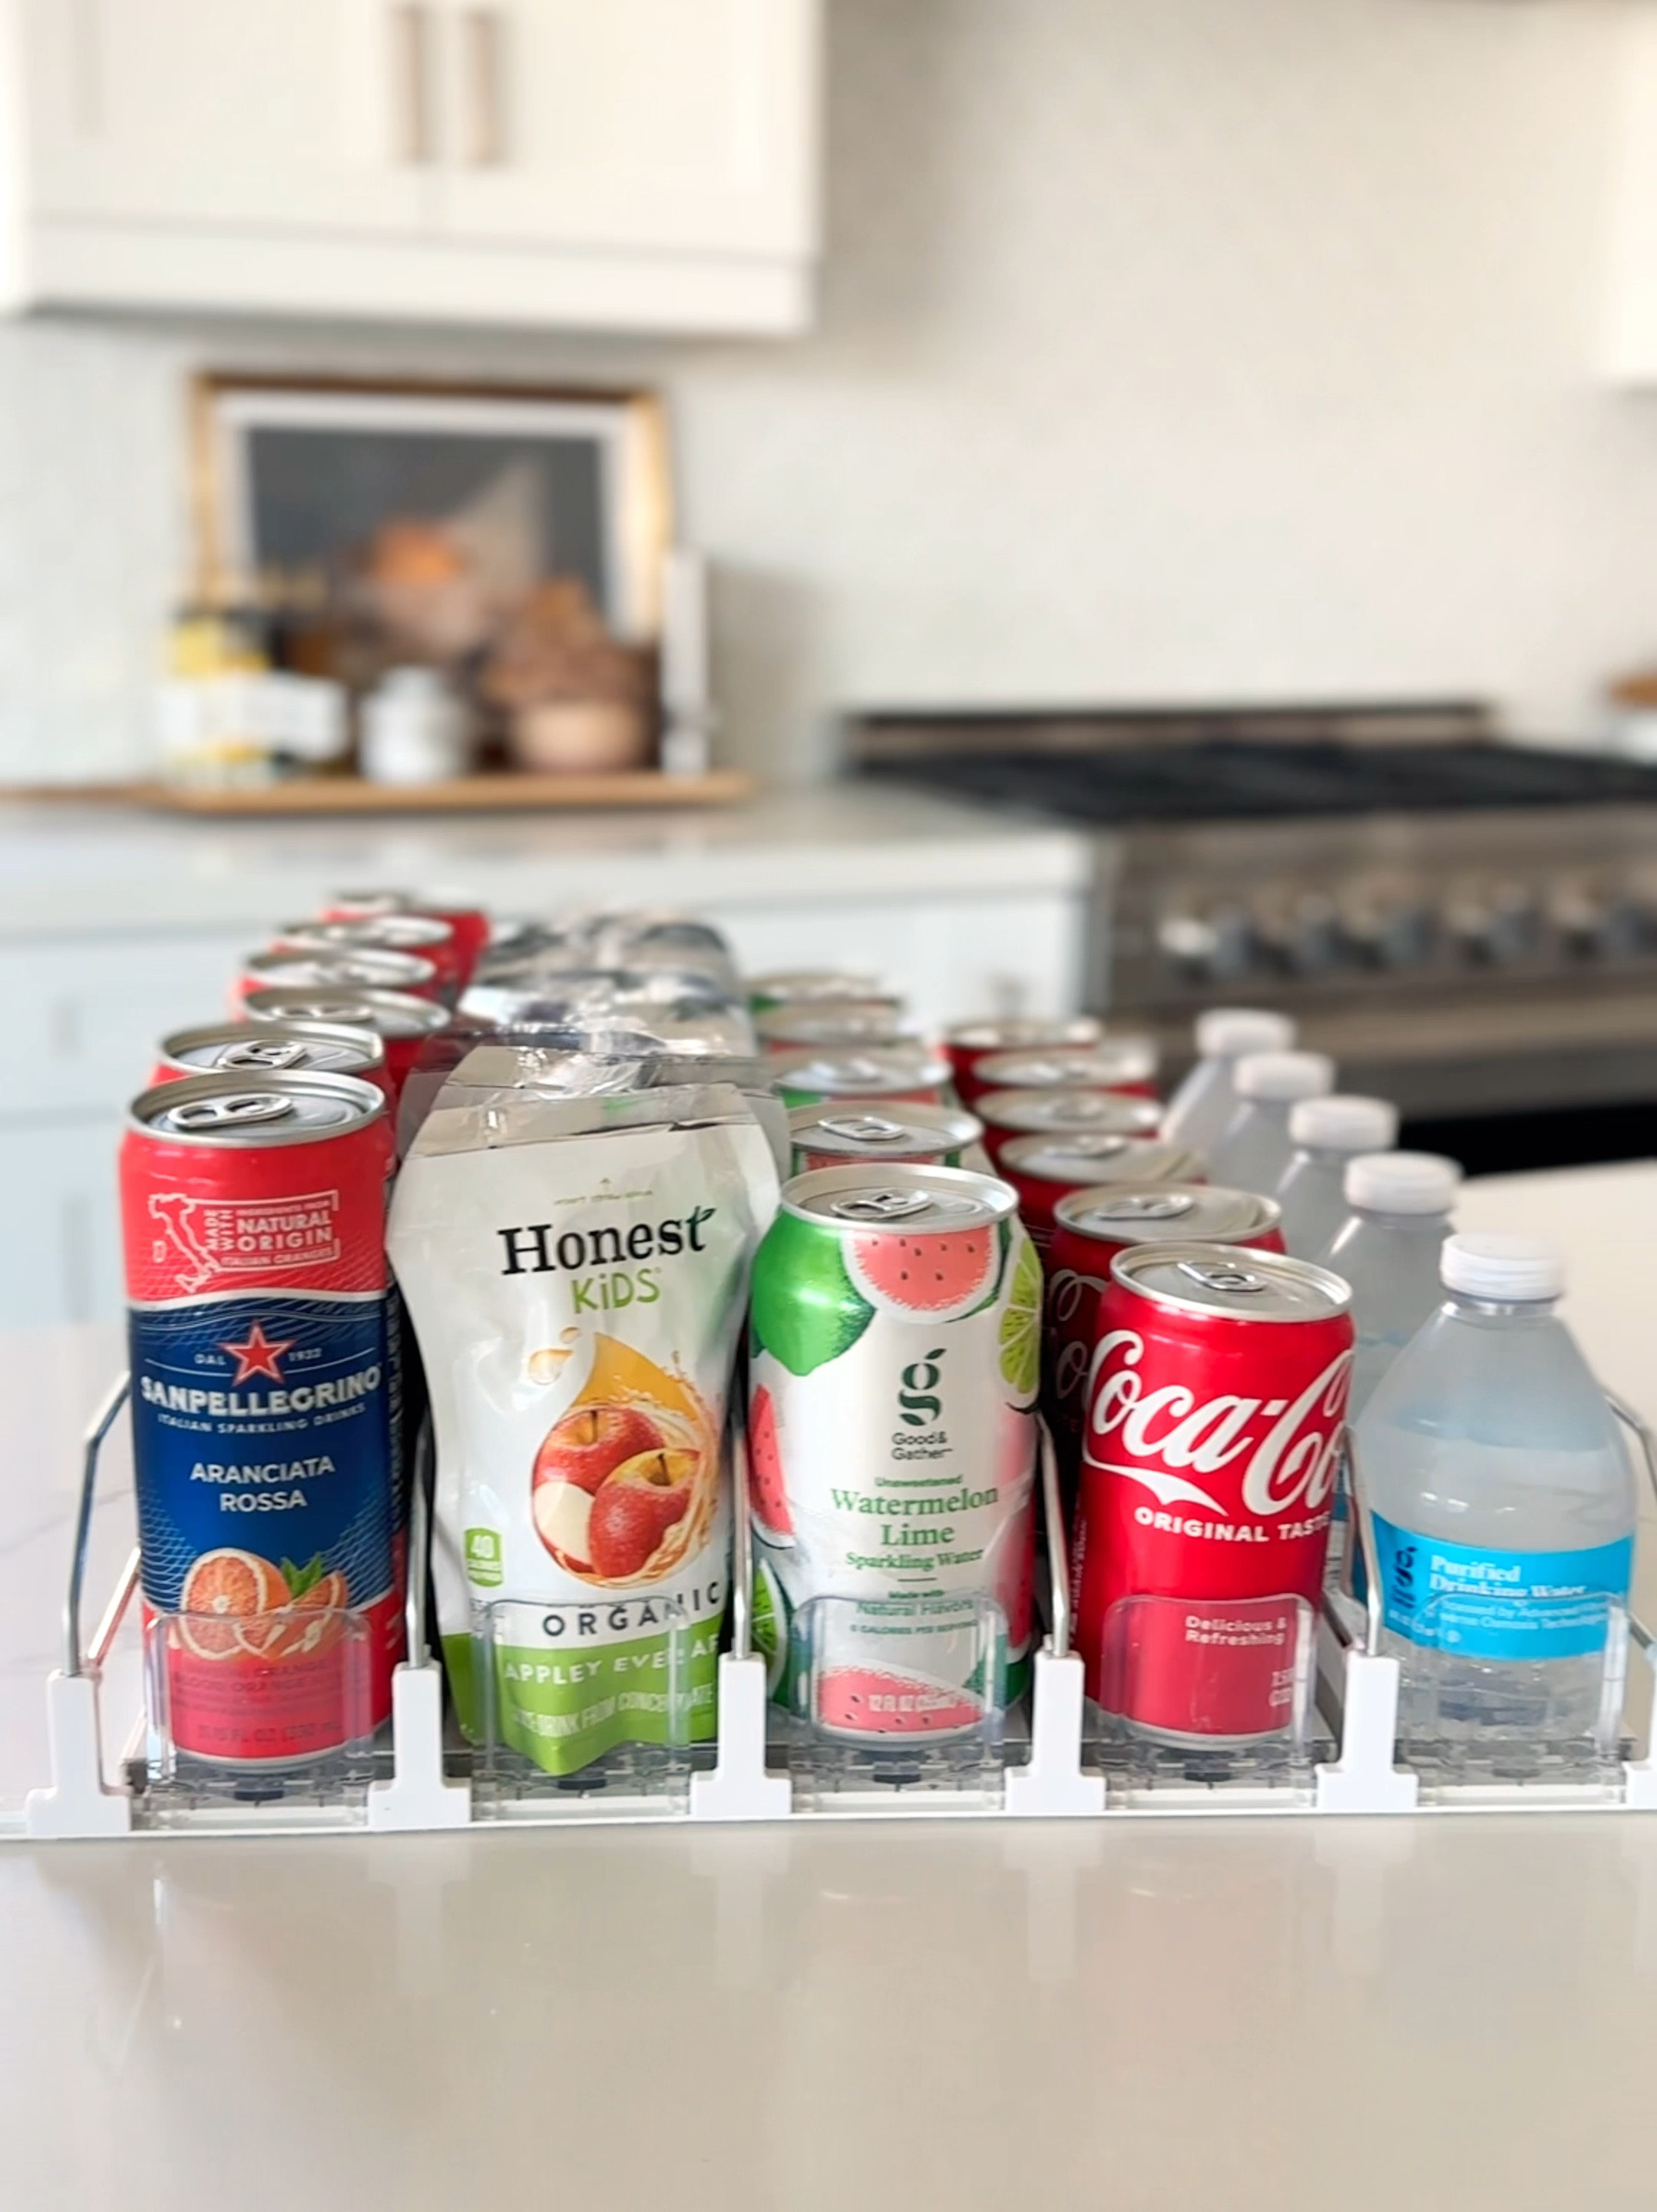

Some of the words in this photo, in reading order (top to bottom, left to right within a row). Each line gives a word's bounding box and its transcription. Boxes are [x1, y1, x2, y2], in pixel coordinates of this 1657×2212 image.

[203, 1210, 219, 1250] MADE
[220, 1210, 234, 1250] WITH
[236, 1210, 332, 1234] NATURAL
[236, 1227, 332, 1252] ORIGIN
[497, 1205, 716, 1275] Honest
[141, 1365, 381, 1417] SANPELLEGRINO
[157, 1413, 212, 1432] ITALIAN
[217, 1419, 308, 1434] SPARKLING
[313, 1403, 365, 1426] DRINKS
[190, 1456, 336, 1484] ARANCIATA
[220, 1489, 307, 1512] ROSSA
[830, 1488, 998, 1515] Watermelon
[881, 1523, 954, 1546] Lime
[1134, 1507, 1270, 1541] ORIGINAL
[471, 1535, 495, 1559] 40
[846, 1551, 934, 1571] Sparkling
[937, 1548, 984, 1566] Water
[1430, 1555, 1521, 1582] Purified
[1429, 1573, 1528, 1597] Drinking
[1530, 1584, 1586, 1598] Water
[1185, 1615, 1273, 1632] Delicious
[1185, 1628, 1285, 1646] Refreshing
[504, 1660, 602, 1685] APPLEY
